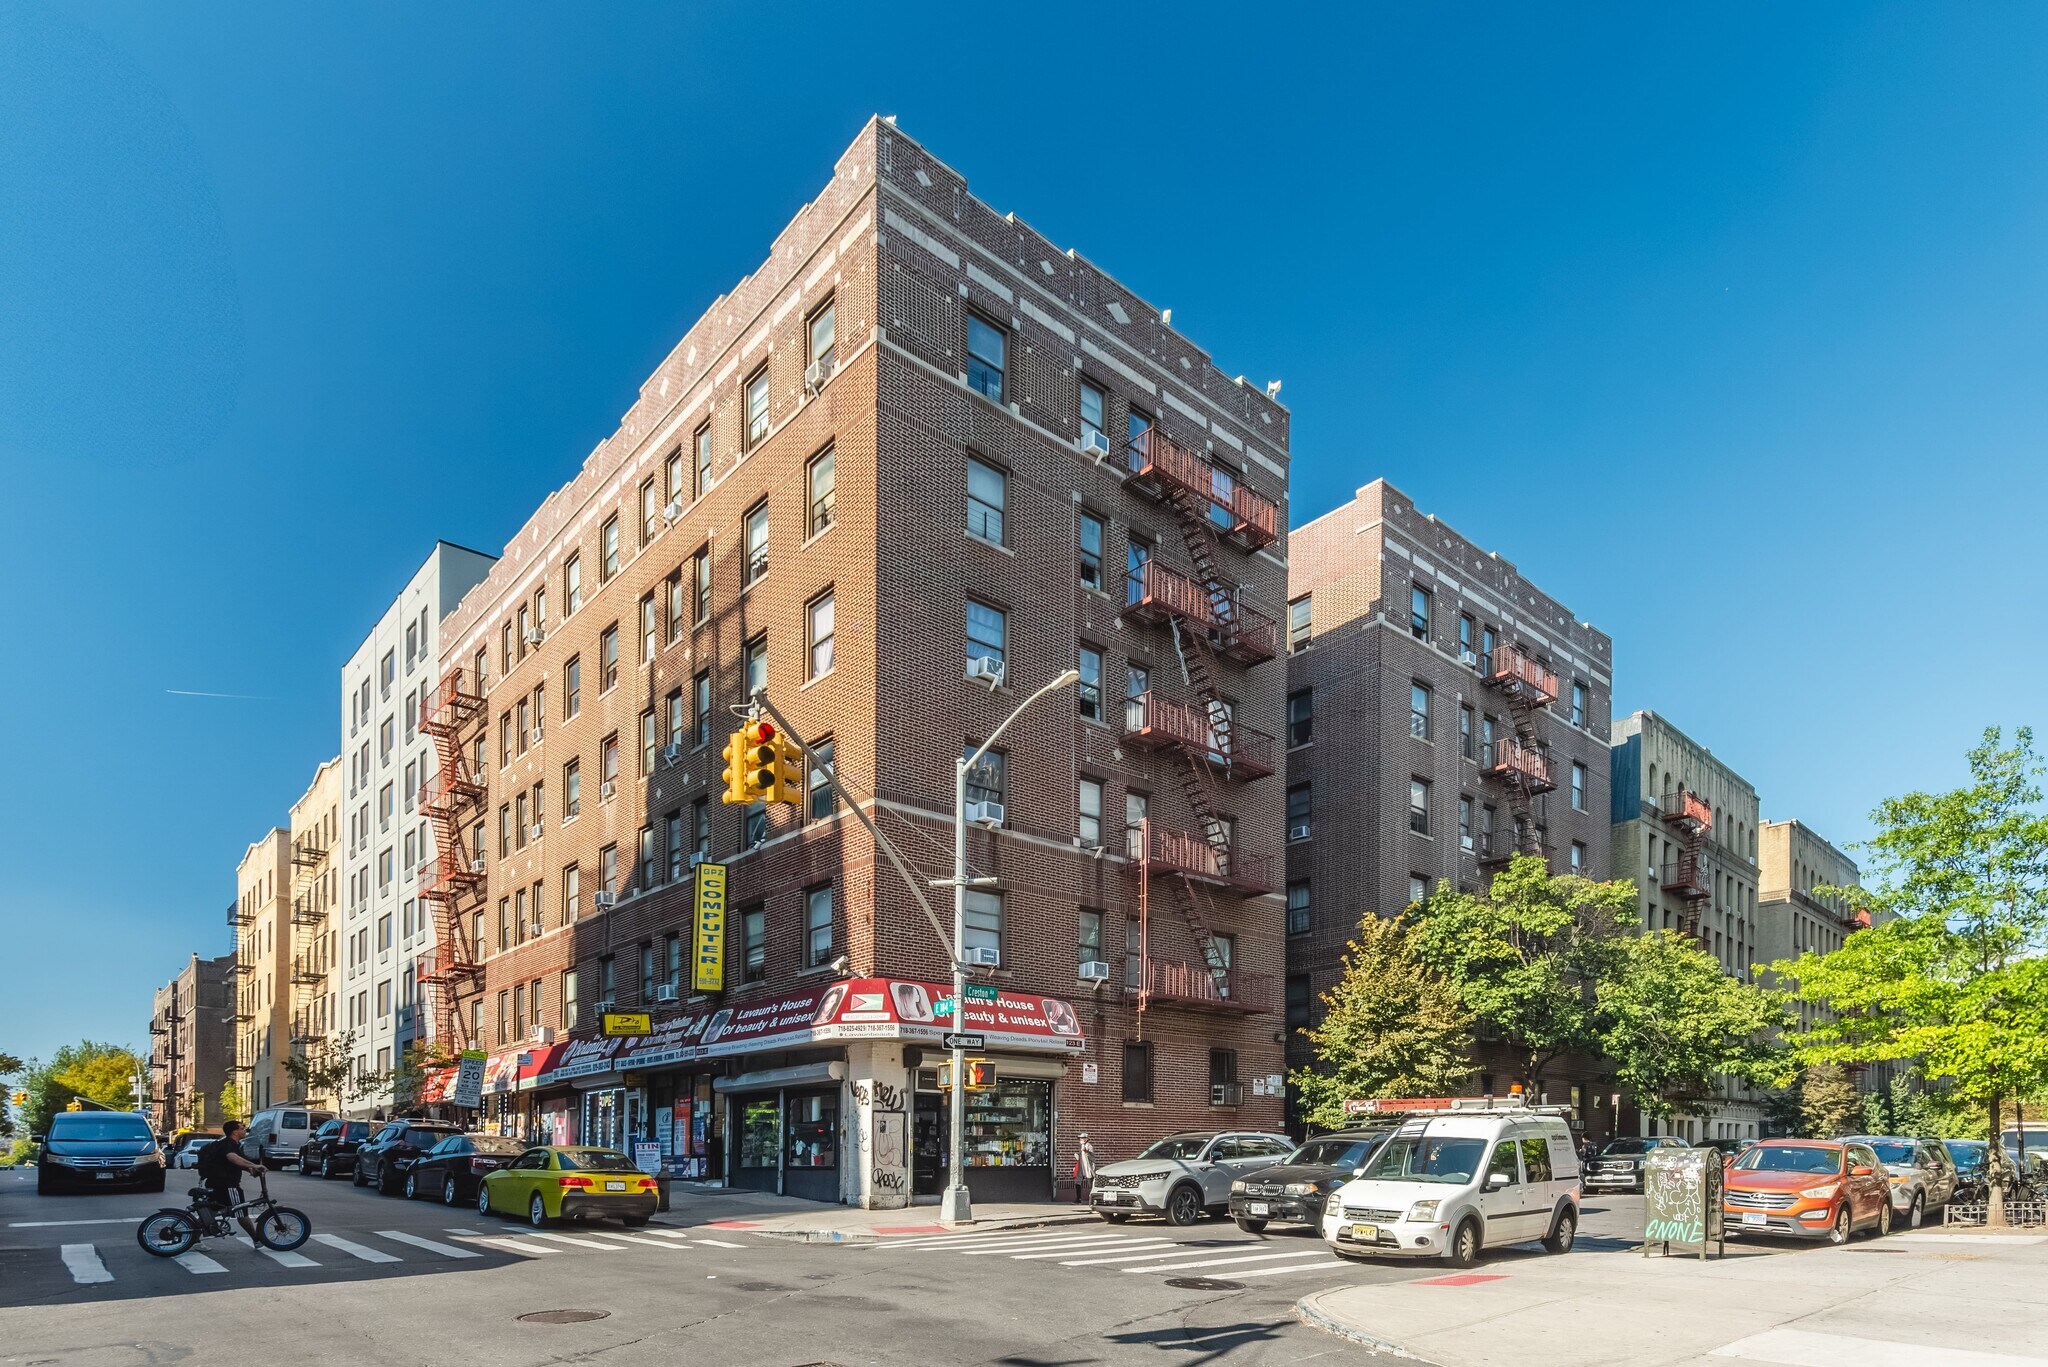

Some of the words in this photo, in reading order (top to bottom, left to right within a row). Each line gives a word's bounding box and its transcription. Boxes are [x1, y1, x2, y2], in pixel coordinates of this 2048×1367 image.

[701, 880, 722, 964] COMPUTER
[968, 986, 988, 998] Creston
[937, 990, 993, 1007] Laun's
[996, 997, 1035, 1011] House
[737, 1003, 778, 1020] Lavaun's
[780, 998, 813, 1012] House
[936, 1004, 940, 1014] E
[722, 1024, 736, 1036] Of
[735, 1019, 768, 1034] beauty
[769, 1017, 778, 1027] &
[780, 1012, 814, 1026] unisex
[964, 1011, 995, 1024] eauty
[998, 1012, 1008, 1024] &
[1011, 1014, 1048, 1027] unisex
[900, 1027, 928, 1035] 718-367-1556
[463, 1071, 480, 1080] 20
[600, 1095, 612, 1107] OPE
